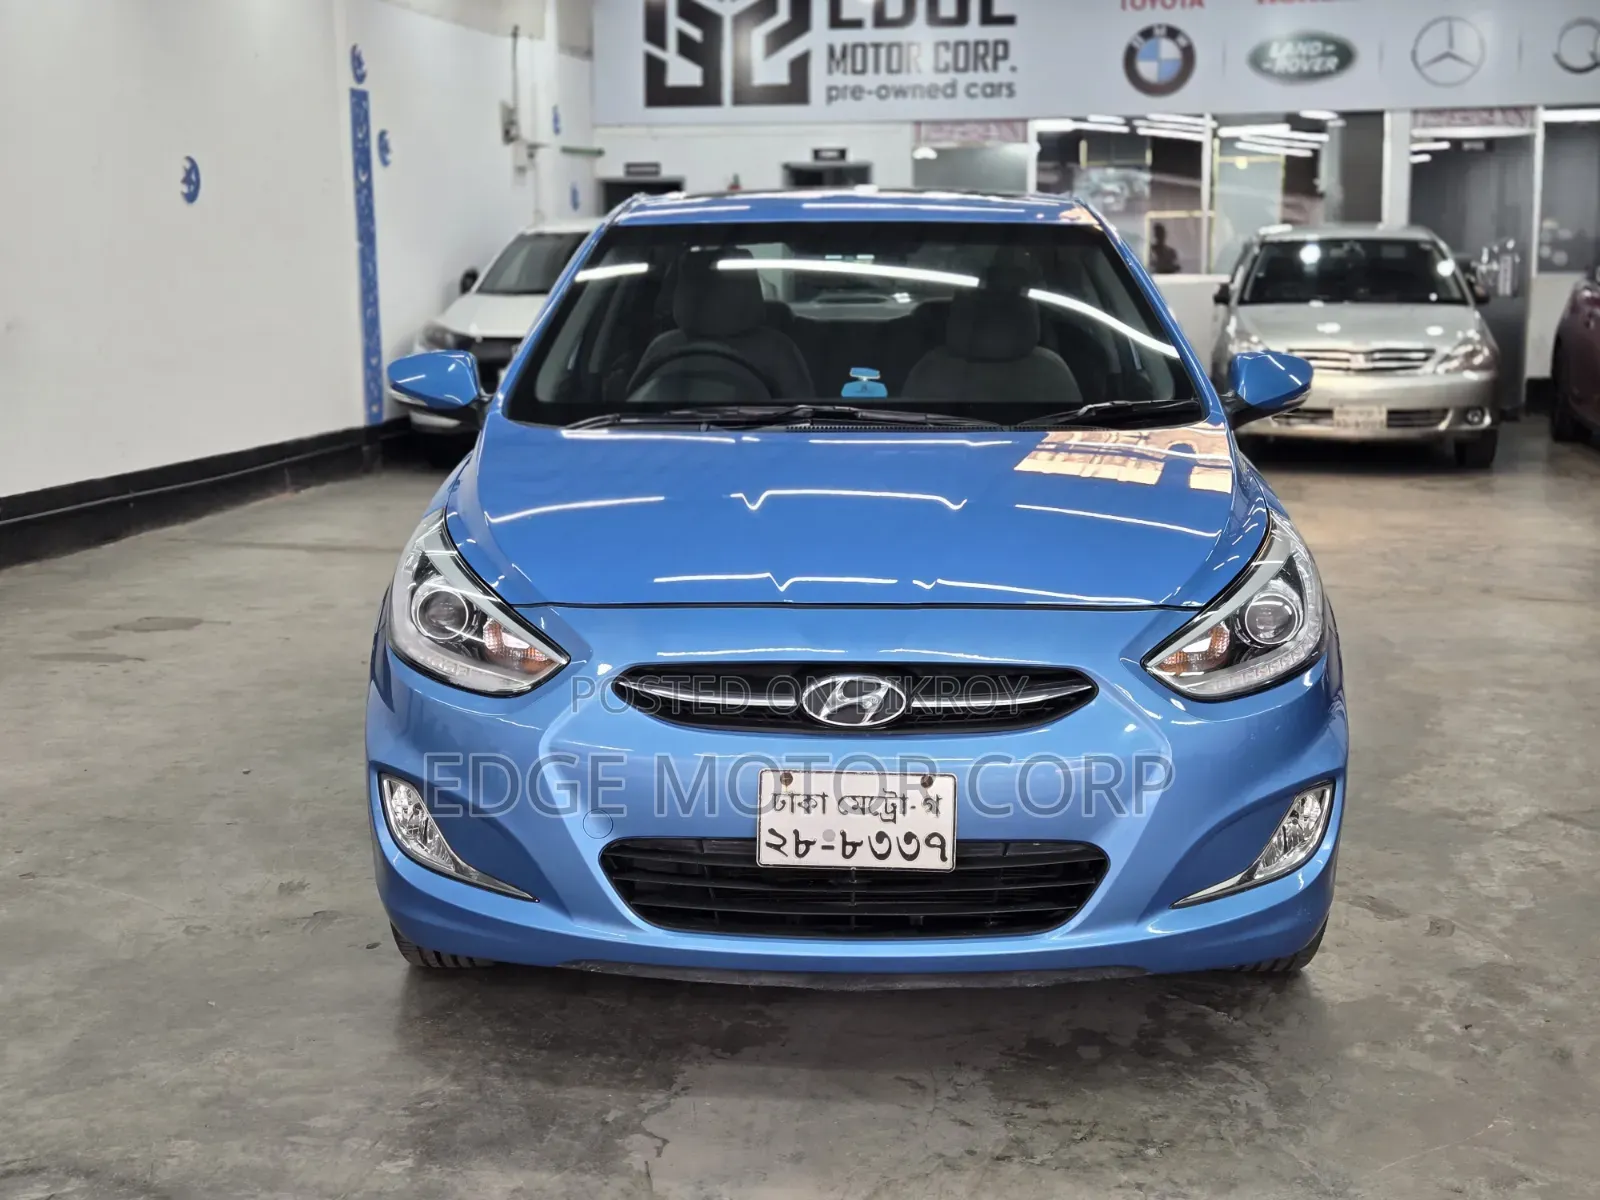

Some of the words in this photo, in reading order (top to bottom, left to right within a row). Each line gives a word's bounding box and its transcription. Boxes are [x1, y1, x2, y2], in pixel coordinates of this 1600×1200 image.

[827, 41, 922, 76] MOTOR
[933, 39, 1018, 74] CORP.
[826, 79, 958, 105] pre-owned
[964, 81, 1016, 99] cars
[772, 792, 828, 815] ঢাকা
[765, 827, 948, 863] ২৮-৮৩৩৭
